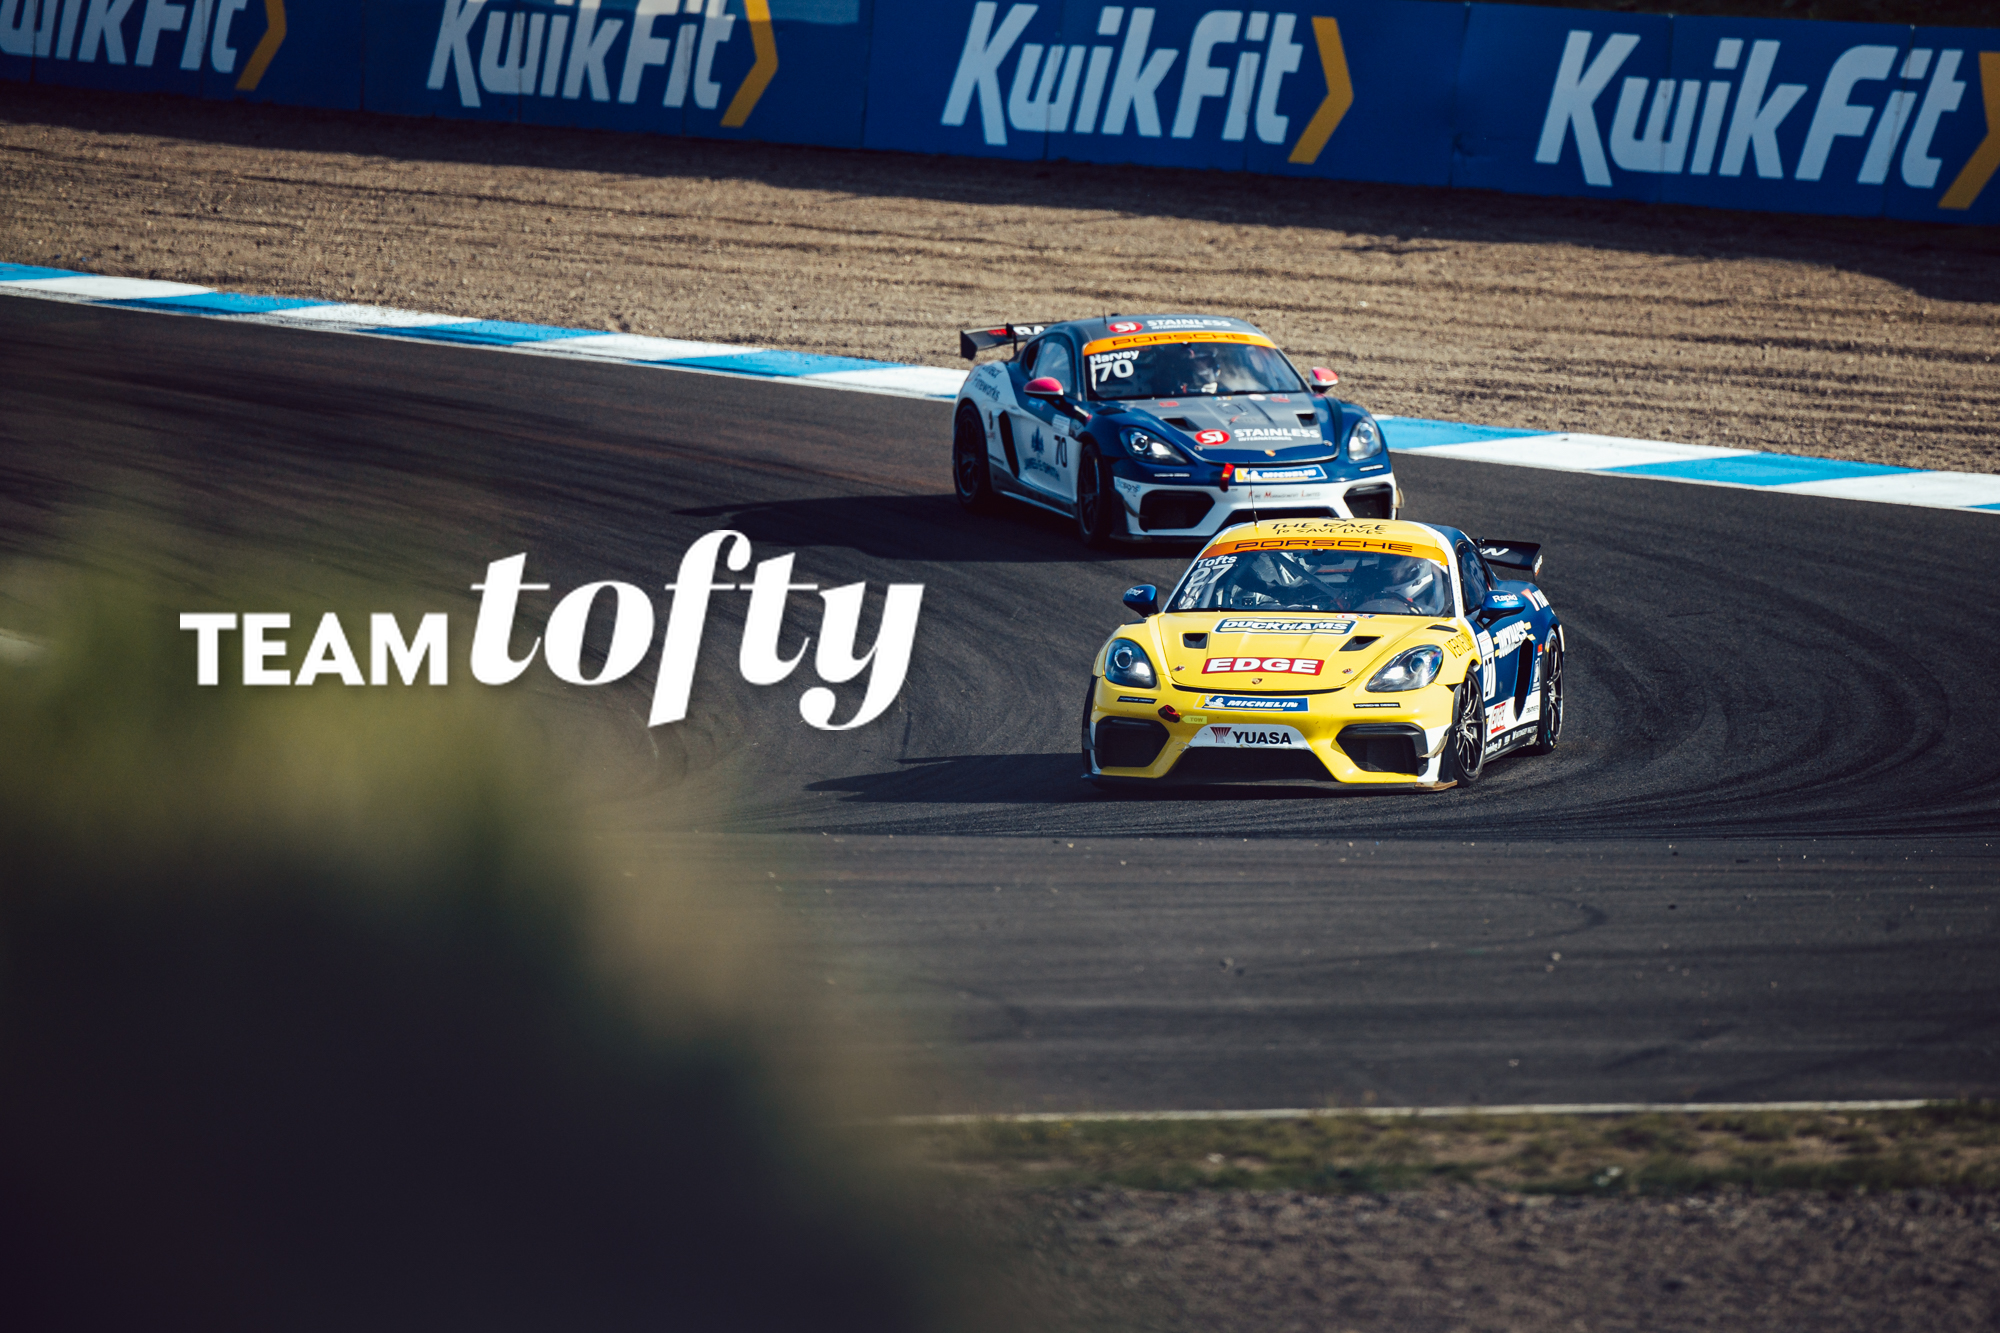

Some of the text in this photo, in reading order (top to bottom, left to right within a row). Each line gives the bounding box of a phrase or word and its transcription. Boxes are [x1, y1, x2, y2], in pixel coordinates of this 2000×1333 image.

[1147, 319, 1232, 327] STAINLESS
[1112, 333, 1251, 347] PORSCHE
[1089, 350, 1140, 364] Harvey
[1095, 359, 1135, 383] 70
[1233, 428, 1320, 438] STAINLESS
[1054, 434, 1068, 468] 70
[1262, 468, 1317, 478] MICHELIN
[1270, 522, 1389, 531] THE RACE
[1234, 539, 1414, 553] PORSCHE
[1197, 555, 1238, 568] Tofts
[1185, 563, 1234, 588] 27
[1492, 593, 1519, 603] Rapid
[1221, 620, 1349, 631] DUCKHAMS
[1206, 657, 1319, 674] EDGE
[1226, 700, 1299, 708] MICHELIN
[1232, 731, 1293, 745] YUASA
